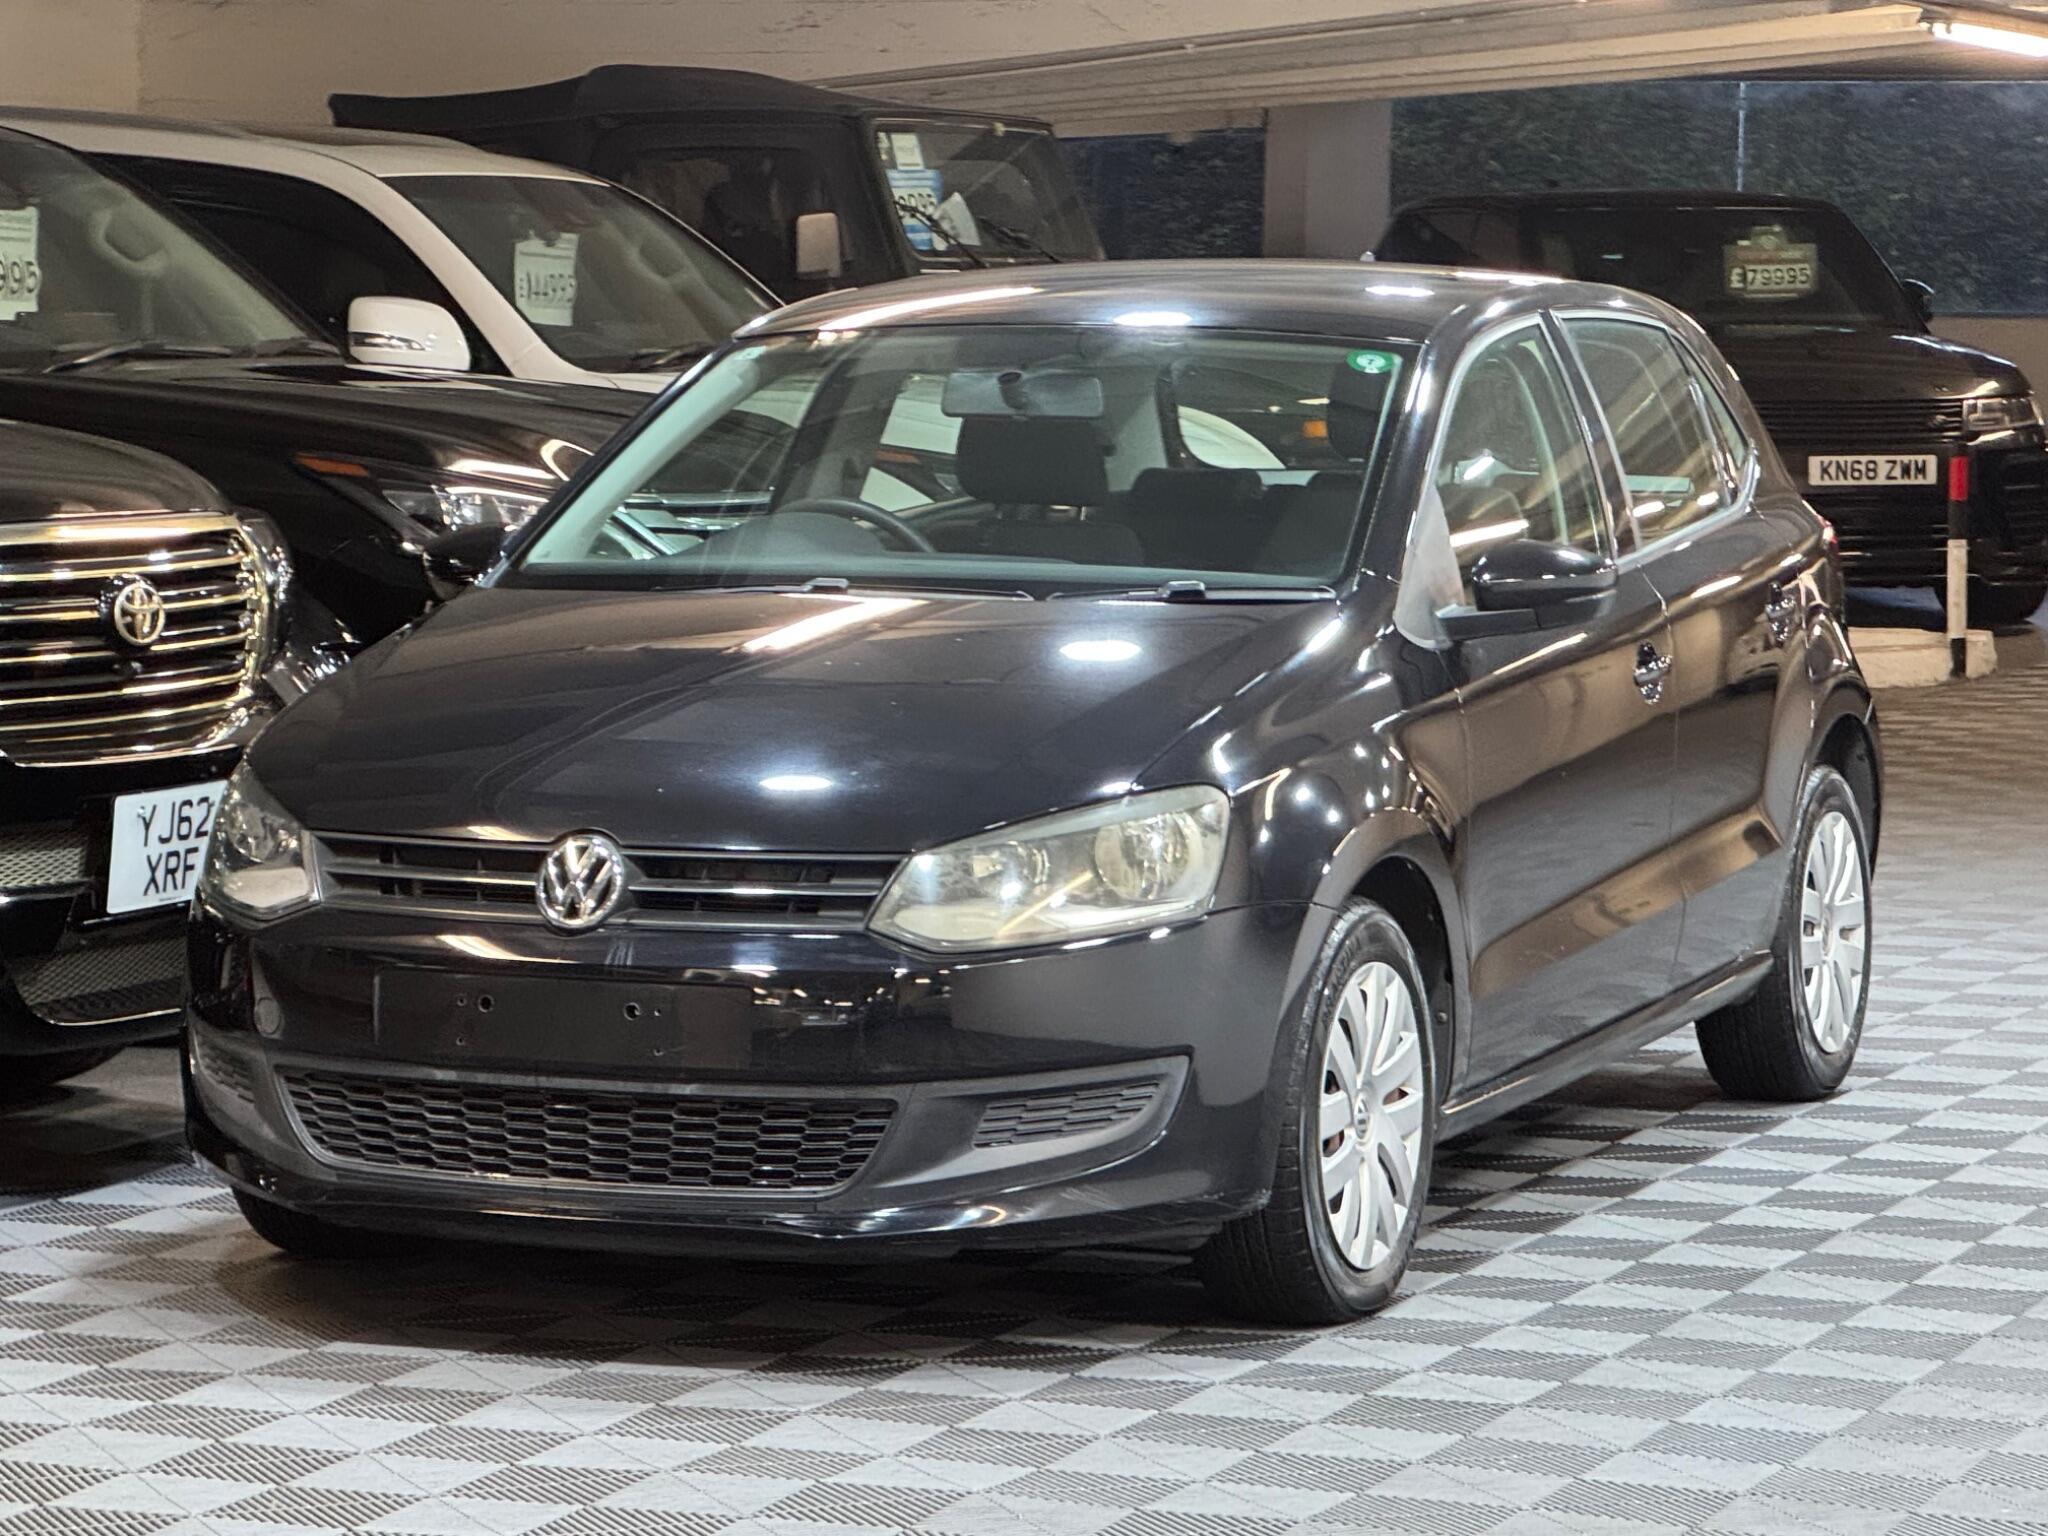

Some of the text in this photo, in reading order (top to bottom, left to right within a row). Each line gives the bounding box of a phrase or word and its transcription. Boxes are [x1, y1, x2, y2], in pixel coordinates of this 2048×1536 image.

[1820, 459, 1878, 481] KN68
[138, 796, 212, 848] YJ62
[143, 847, 200, 896] XRF
